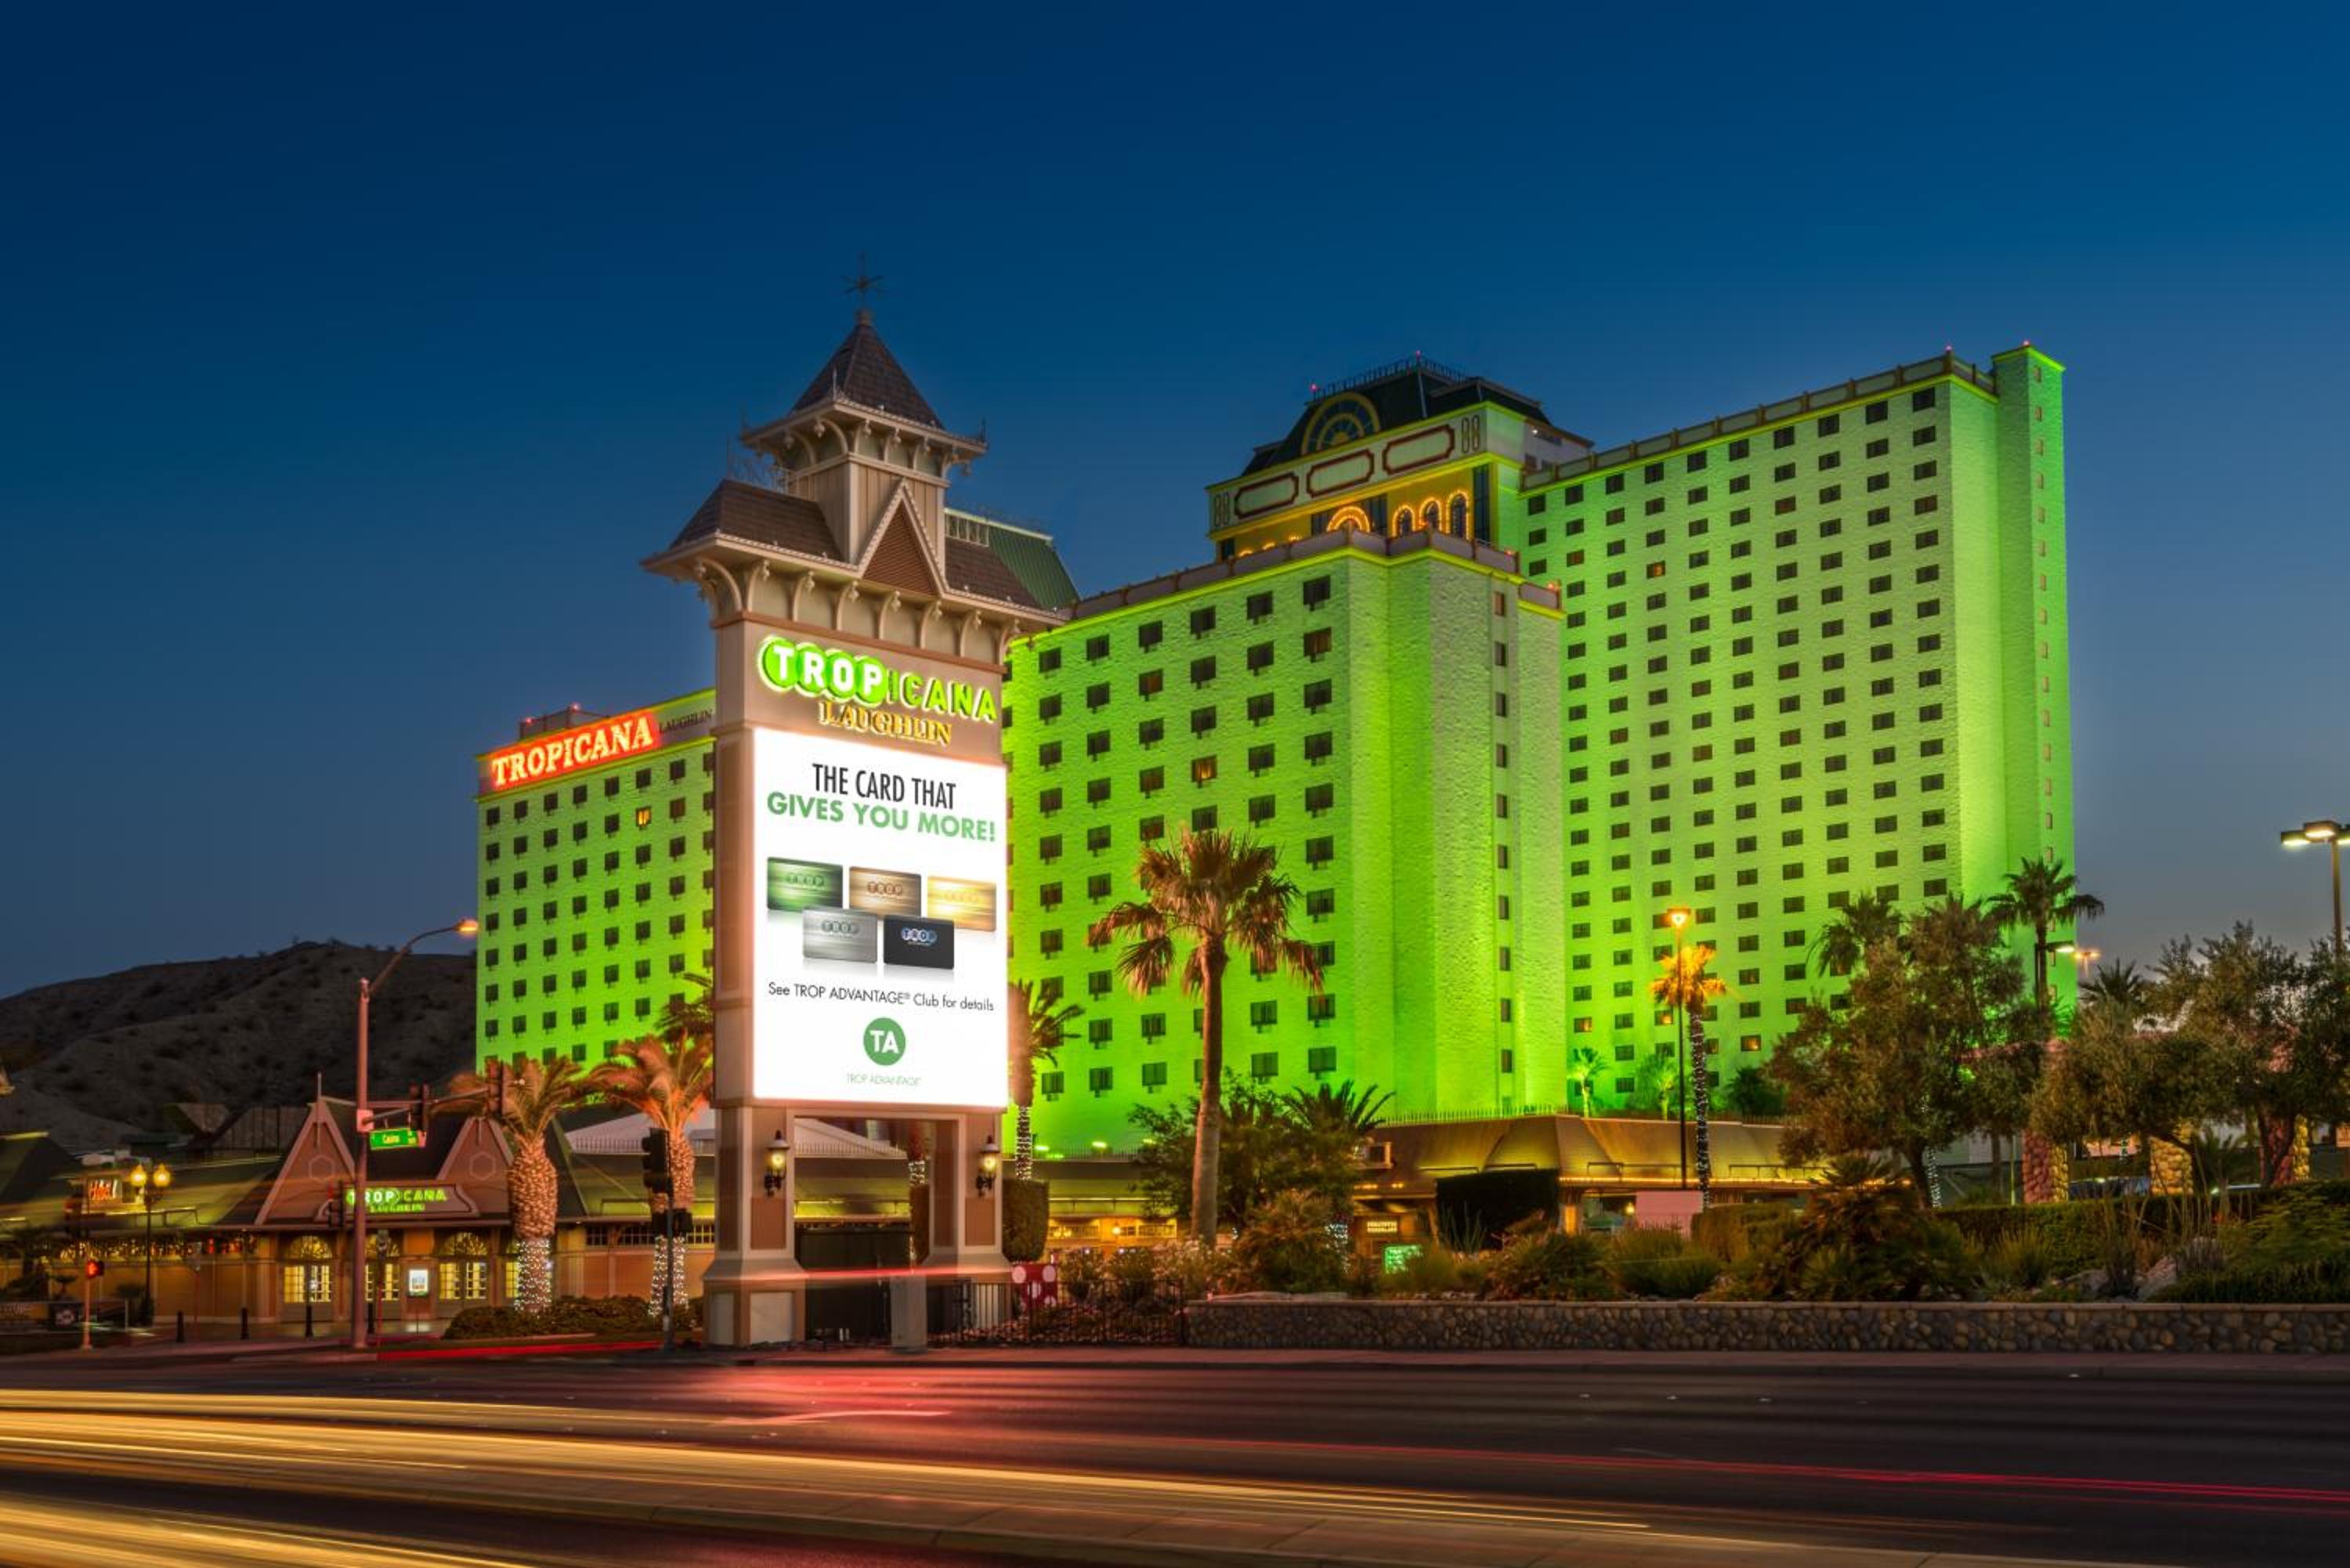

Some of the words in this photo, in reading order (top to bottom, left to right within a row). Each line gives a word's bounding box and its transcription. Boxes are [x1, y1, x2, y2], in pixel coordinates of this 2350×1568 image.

[761, 638, 997, 723] TROPICANA
[659, 710, 712, 734] LAUGHLIN
[819, 700, 952, 746] LAUGHLIN
[491, 714, 653, 787] TROPICANA
[812, 763, 848, 795] THE
[855, 770, 906, 802] CARD
[911, 777, 956, 810] THAT
[766, 790, 844, 822] GIVES
[852, 803, 909, 831] YOU
[917, 811, 996, 842] MORE!
[867, 881, 903, 896] TROP
[768, 981, 790, 995] See
[794, 983, 826, 999] TROP
[913, 992, 939, 1007] Club
[942, 994, 957, 1008] for
[960, 995, 994, 1011] details
[870, 1030, 900, 1053] TA
